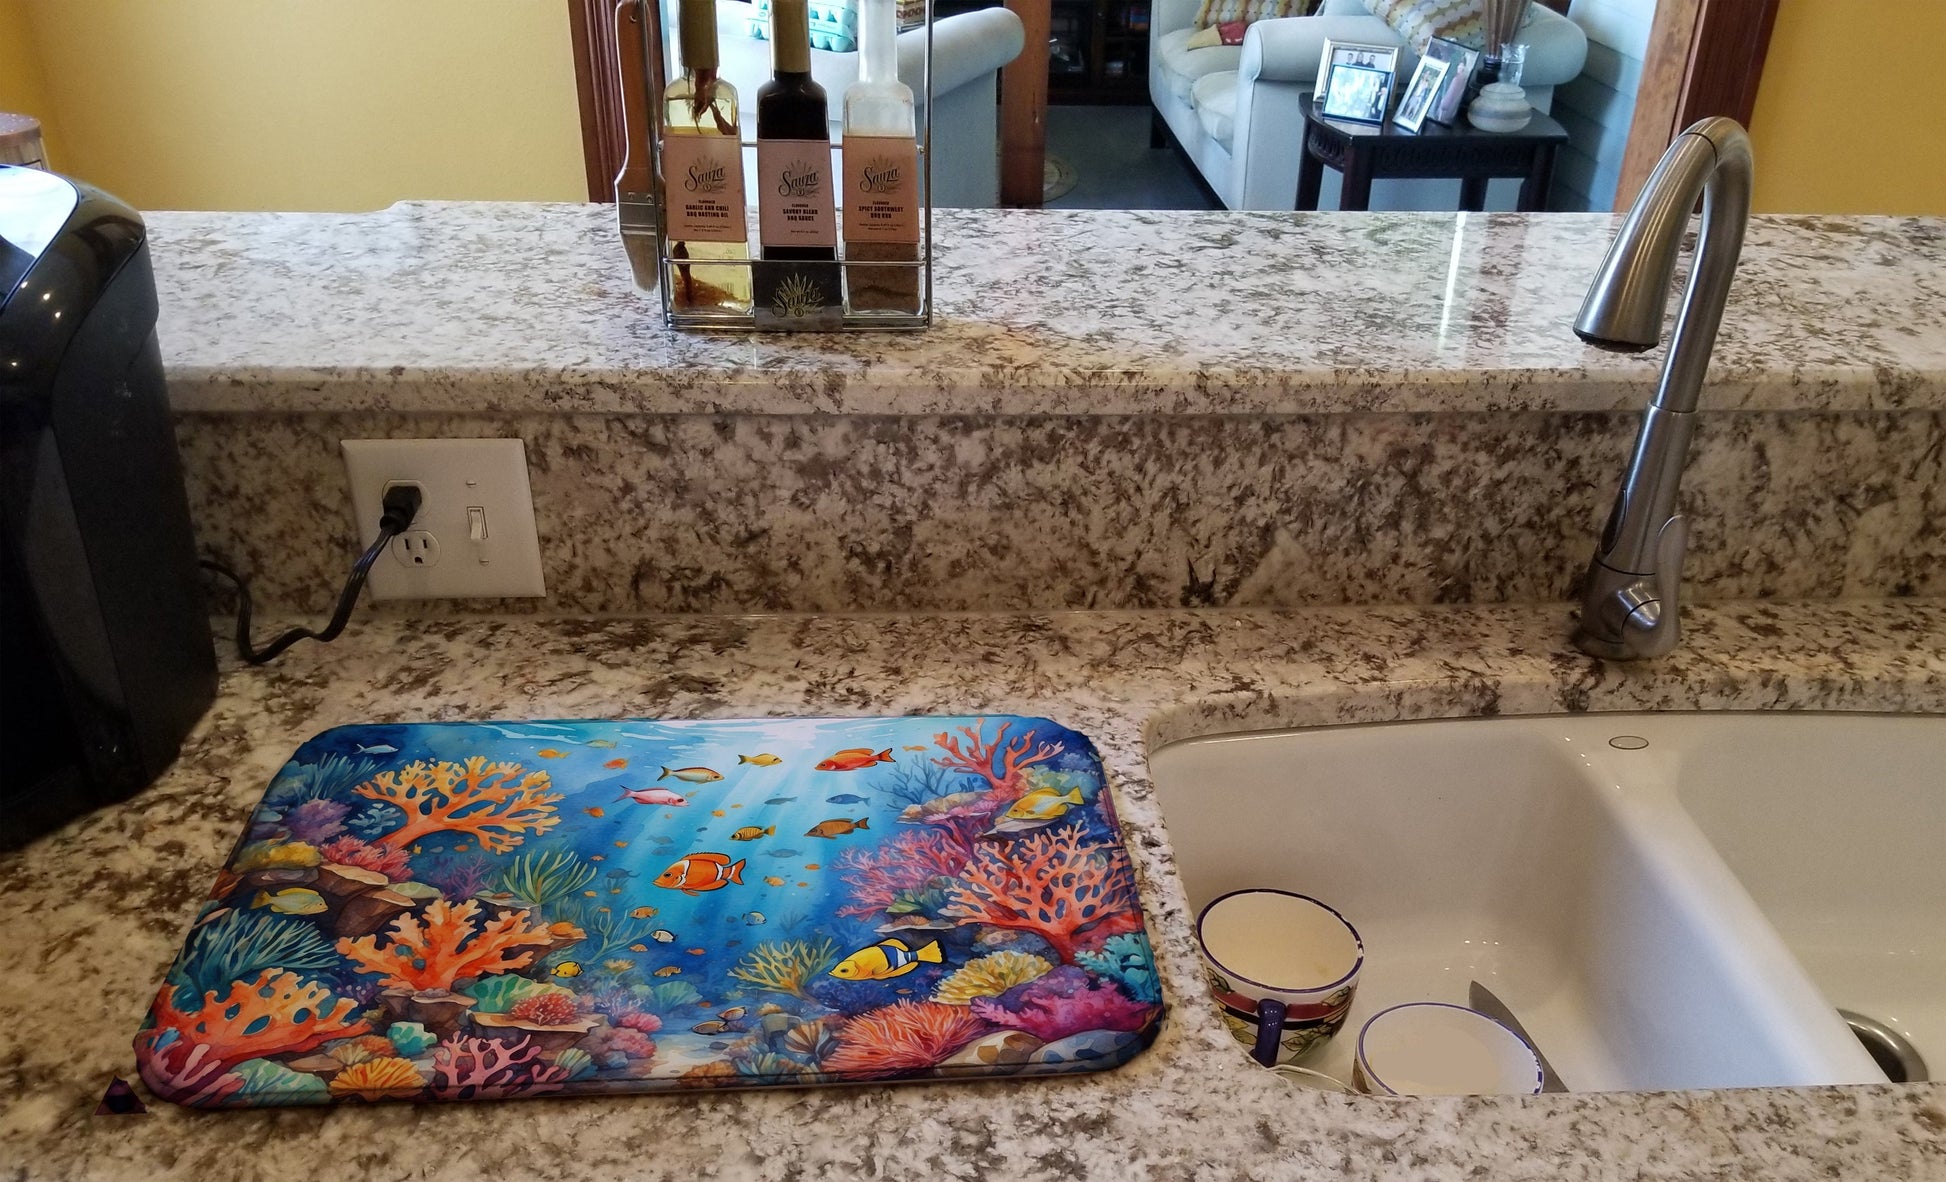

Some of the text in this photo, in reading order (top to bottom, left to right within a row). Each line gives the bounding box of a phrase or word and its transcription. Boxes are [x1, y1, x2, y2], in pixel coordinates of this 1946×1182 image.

[685, 166, 725, 192] Sauza
[778, 171, 818, 197] Sauza
[859, 166, 900, 193] Sauza
[771, 287, 822, 317] Sauza
